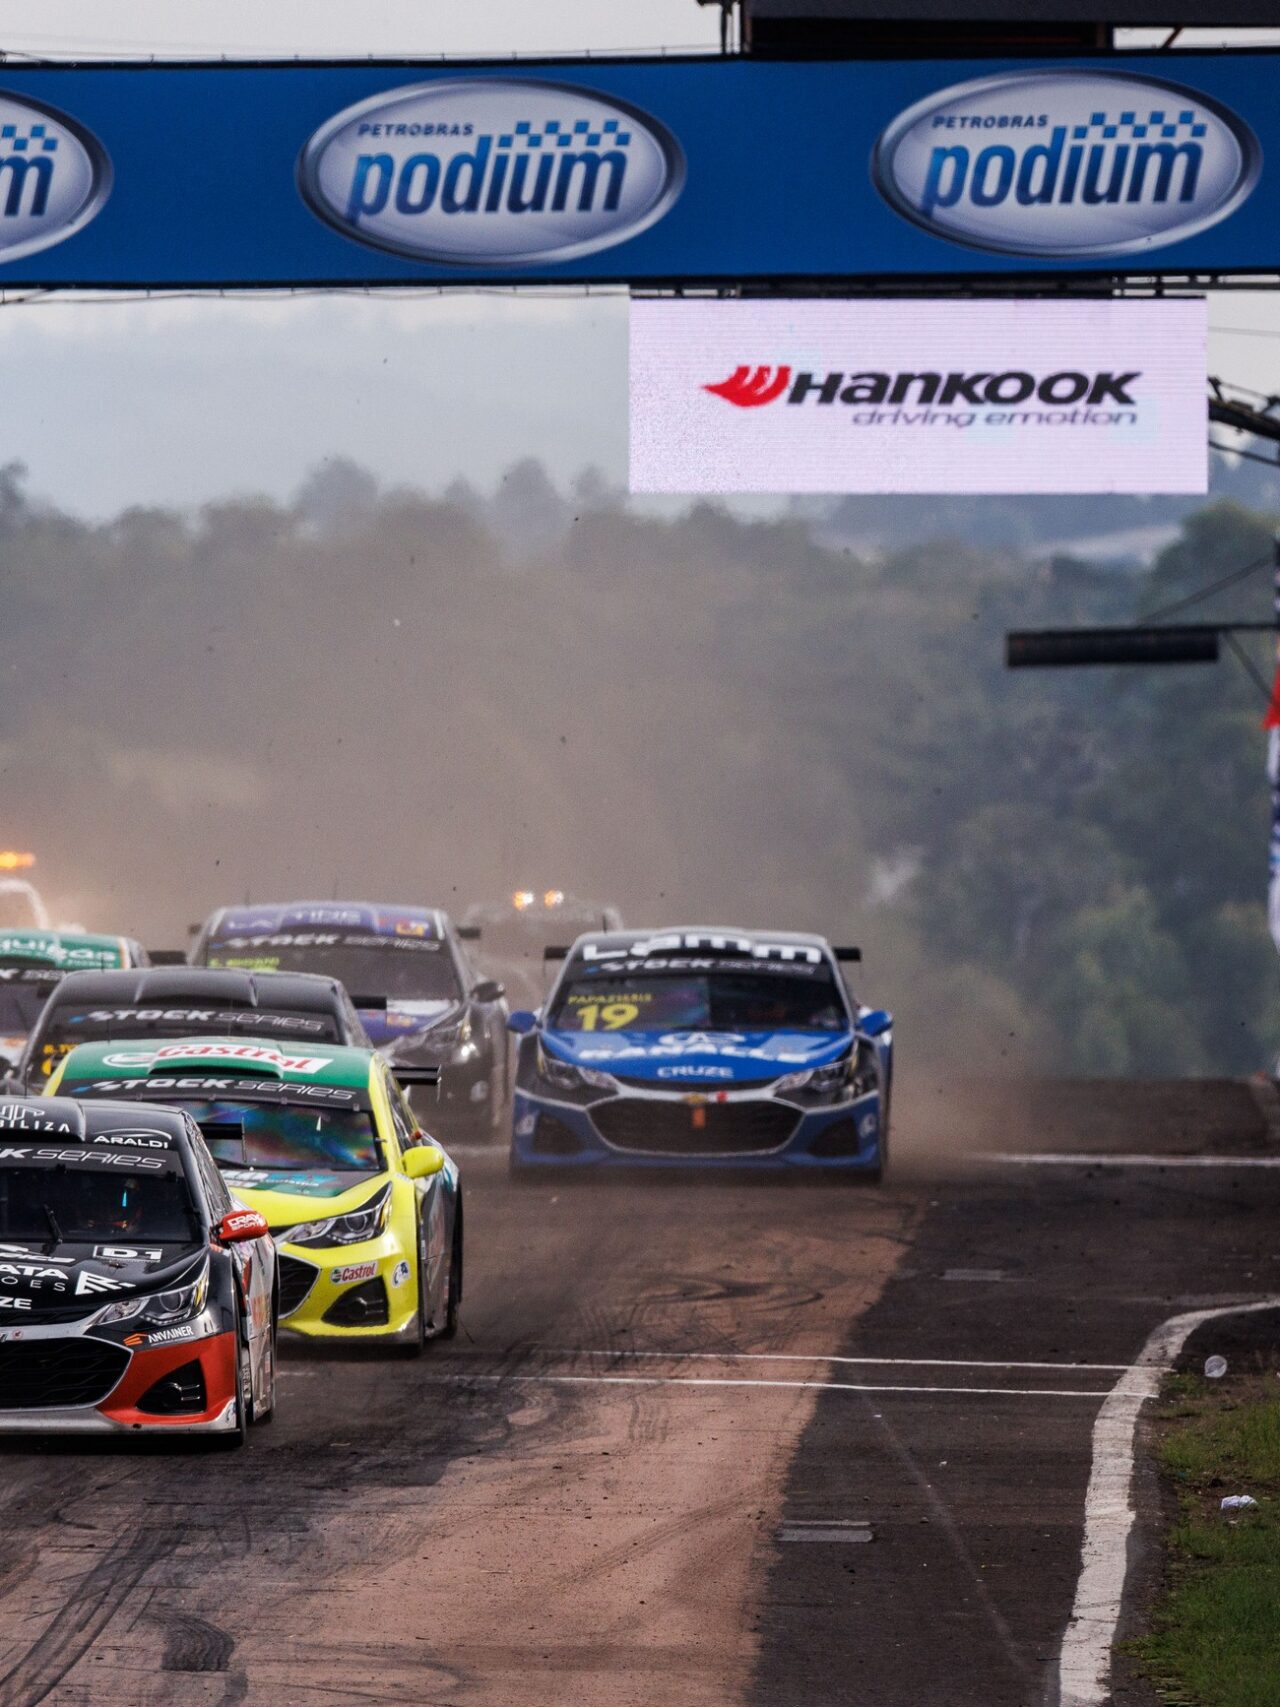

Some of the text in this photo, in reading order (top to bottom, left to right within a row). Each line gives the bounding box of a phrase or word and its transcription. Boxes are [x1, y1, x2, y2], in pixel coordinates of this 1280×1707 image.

[358, 123, 473, 140] PETROBRAS
[932, 114, 1048, 129] PETROBRAS
[345, 135, 628, 226] podium
[923, 125, 1205, 216] podium
[852, 408, 1139, 428] driving emotion
[68, 1009, 325, 1032] STOCK SERIES
[577, 1004, 639, 1031] 19
[158, 1045, 314, 1070] Castrol
[656, 1065, 735, 1079] CRUZE
[71, 1078, 358, 1100] STOCK SERIES
[93, 1134, 169, 1149] ARALDI
[32, 1149, 167, 1169] SERIES
[102, 1247, 162, 1260] D1
[342, 1262, 377, 1281] Castrol
[148, 1325, 194, 1343] ANVAINER
